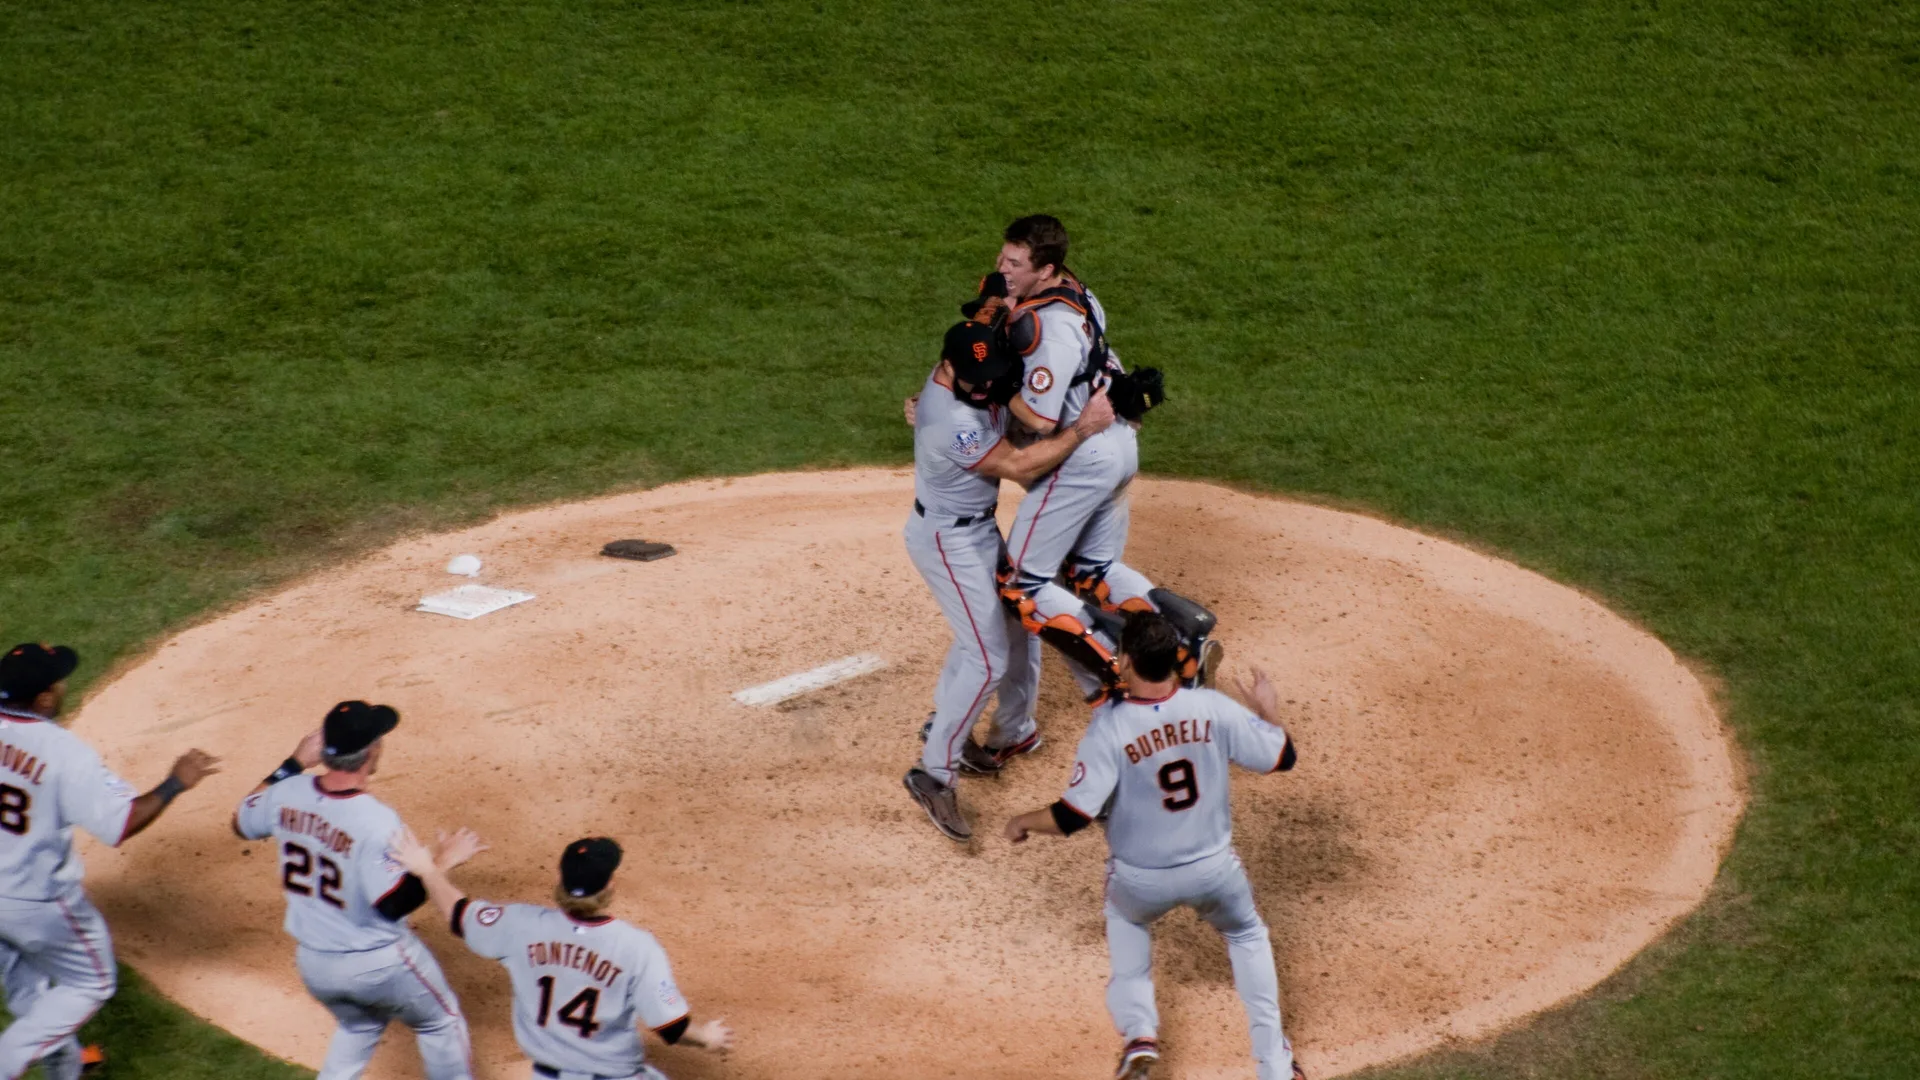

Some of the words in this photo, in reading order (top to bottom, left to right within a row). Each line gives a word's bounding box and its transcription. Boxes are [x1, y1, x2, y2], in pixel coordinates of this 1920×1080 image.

[0, 741, 47, 786] OVAL
[1124, 719, 1212, 765] BURRELL
[1158, 757, 1199, 812] 9
[283, 841, 345, 910] 22
[527, 942, 623, 988] FONTENOT
[536, 975, 600, 1038] 14
